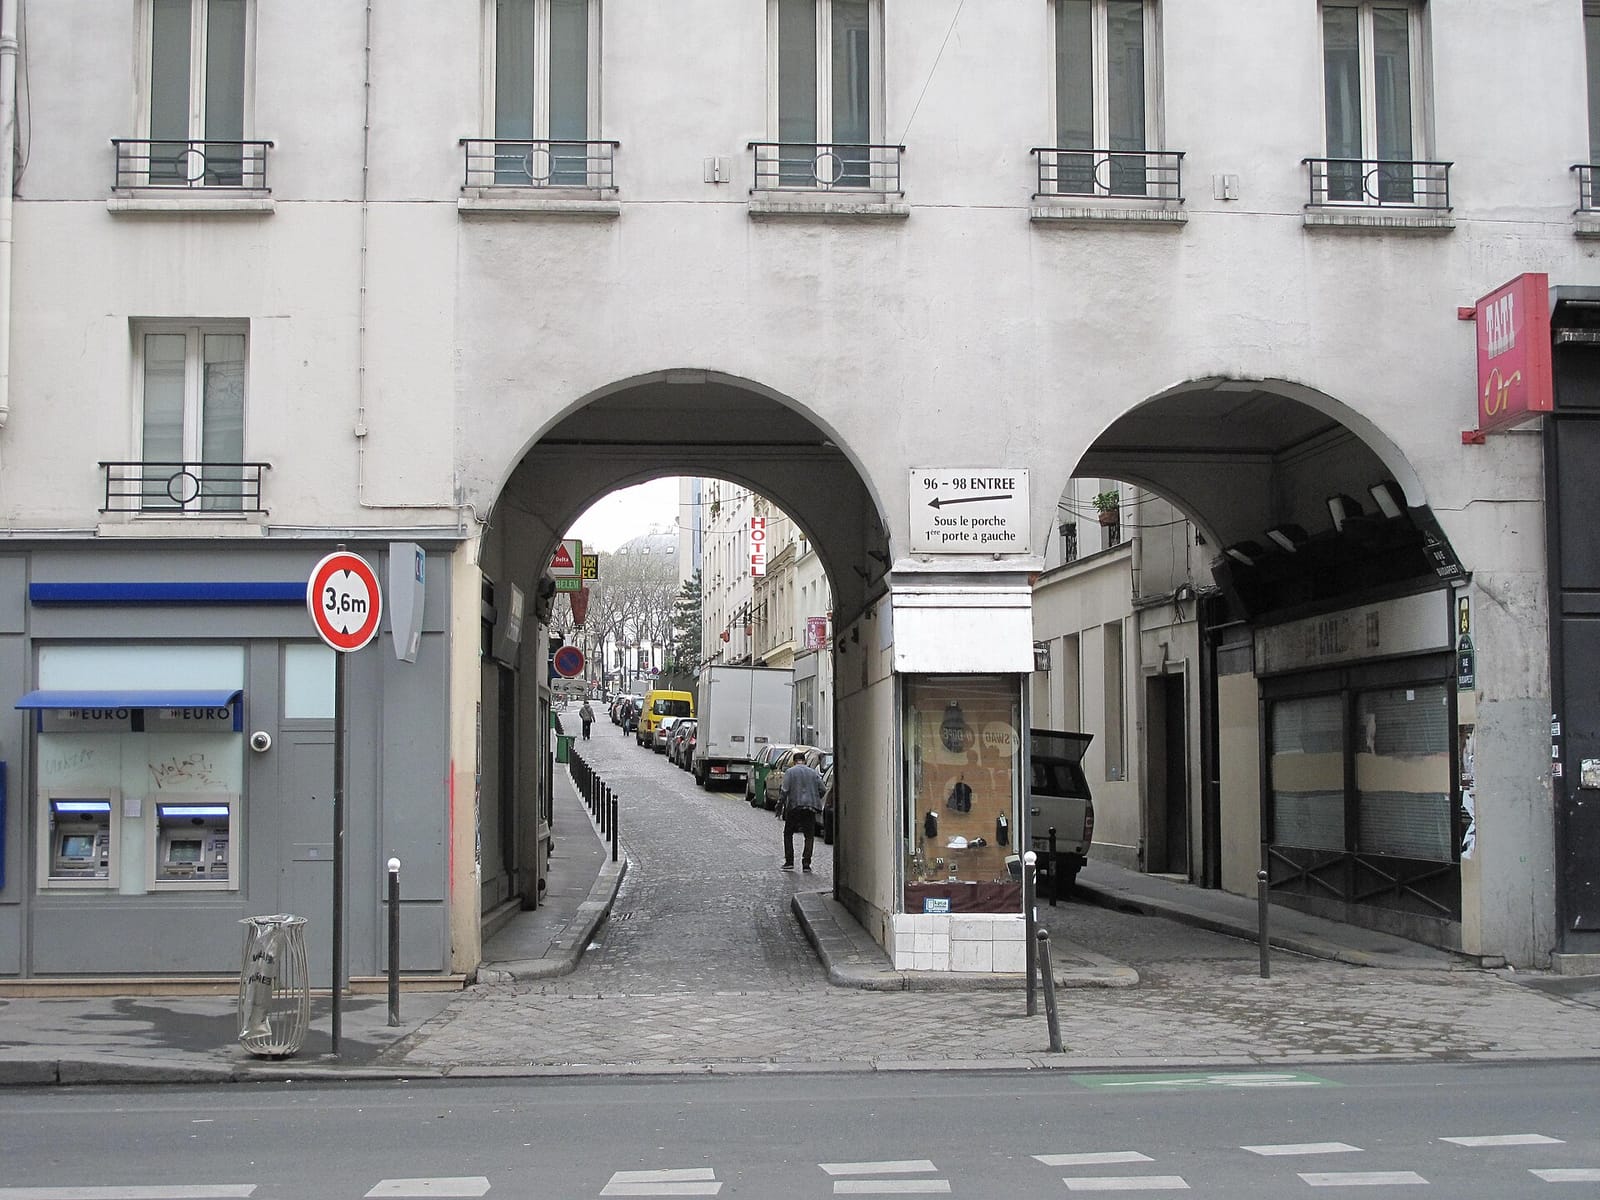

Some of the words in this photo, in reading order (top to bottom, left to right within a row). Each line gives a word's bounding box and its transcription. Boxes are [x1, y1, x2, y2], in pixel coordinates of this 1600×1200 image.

[1486, 293, 1515, 359] TATI
[1485, 368, 1520, 415] Or
[923, 478, 938, 490] 96
[952, 478, 967, 490] 98
[934, 516, 957, 526] Sous
[960, 515, 969, 526] le
[971, 515, 1006, 528] porche
[942, 532, 970, 543] porte
[981, 530, 1016, 543] gauche
[751, 517, 766, 577] HOTEL
[582, 568, 596, 579] EC
[82, 708, 129, 720] EURO
[183, 708, 230, 720] EURO
